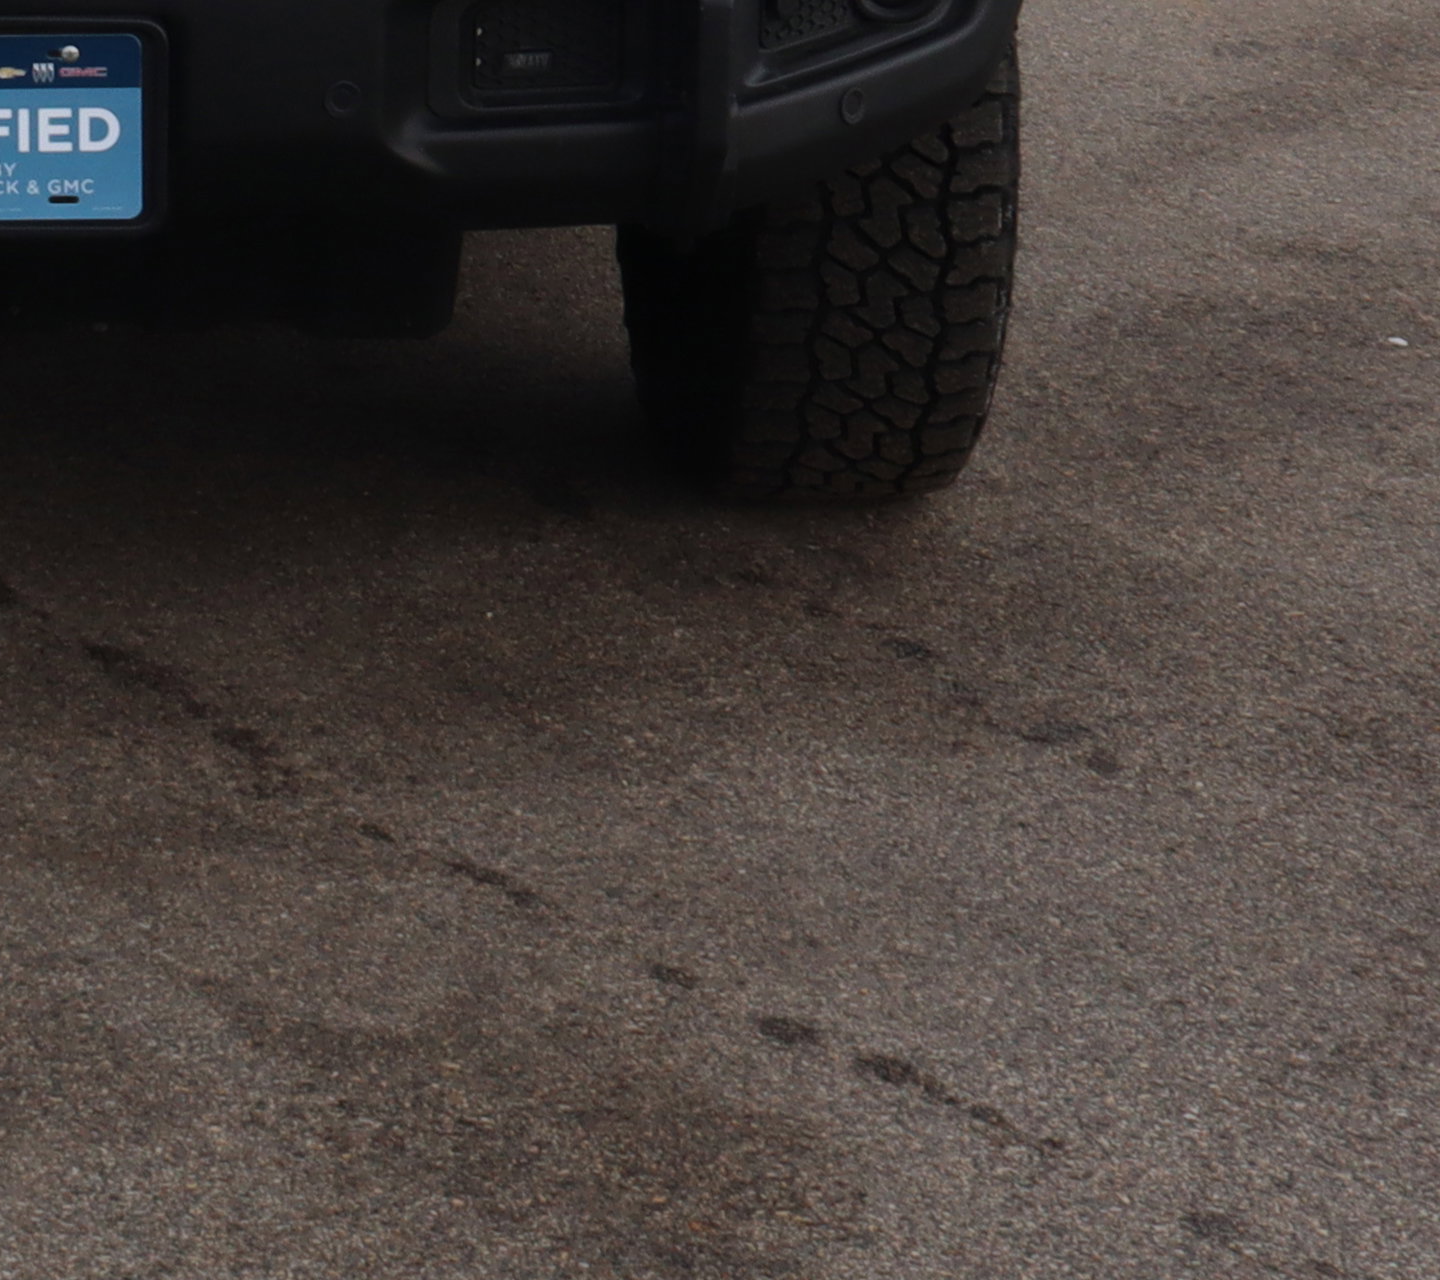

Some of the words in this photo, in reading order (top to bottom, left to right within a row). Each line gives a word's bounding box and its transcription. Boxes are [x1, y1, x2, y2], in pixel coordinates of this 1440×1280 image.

[59, 66, 108, 78] GMC
[27, 180, 40, 195] &
[47, 179, 95, 195] GMC
